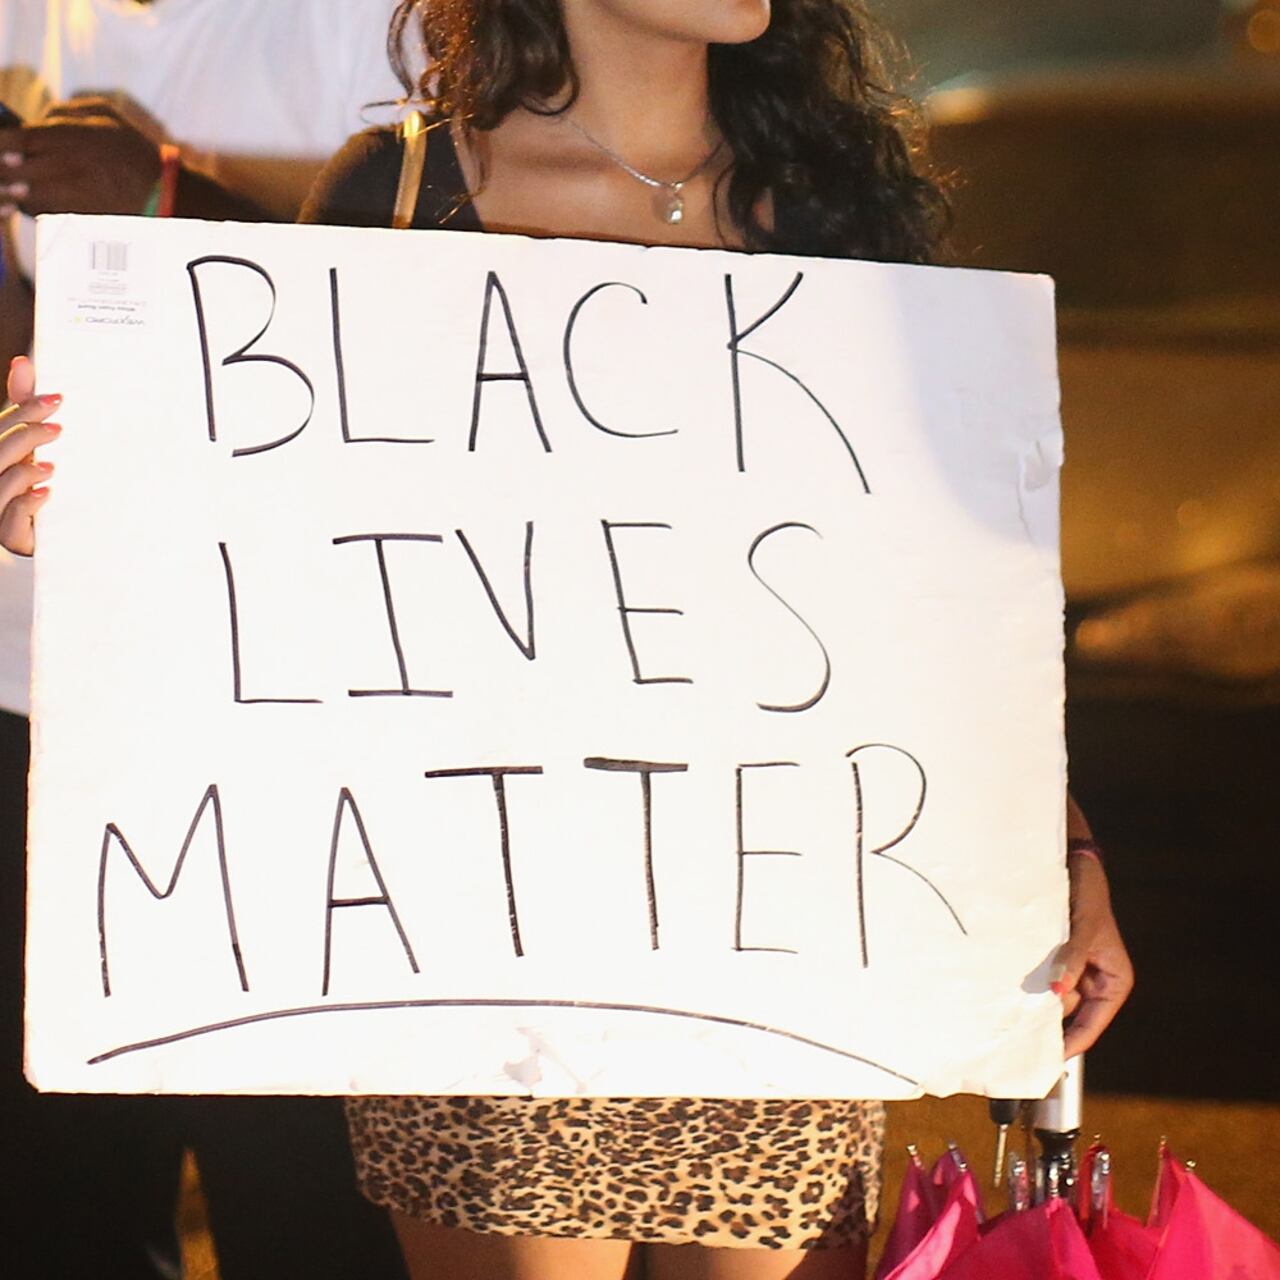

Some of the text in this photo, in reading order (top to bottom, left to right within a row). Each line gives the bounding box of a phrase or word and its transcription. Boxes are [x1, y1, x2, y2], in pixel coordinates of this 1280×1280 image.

[186, 255, 872, 495] BLACK
[218, 519, 833, 714] LIVES
[96, 742, 969, 998] MATTER
